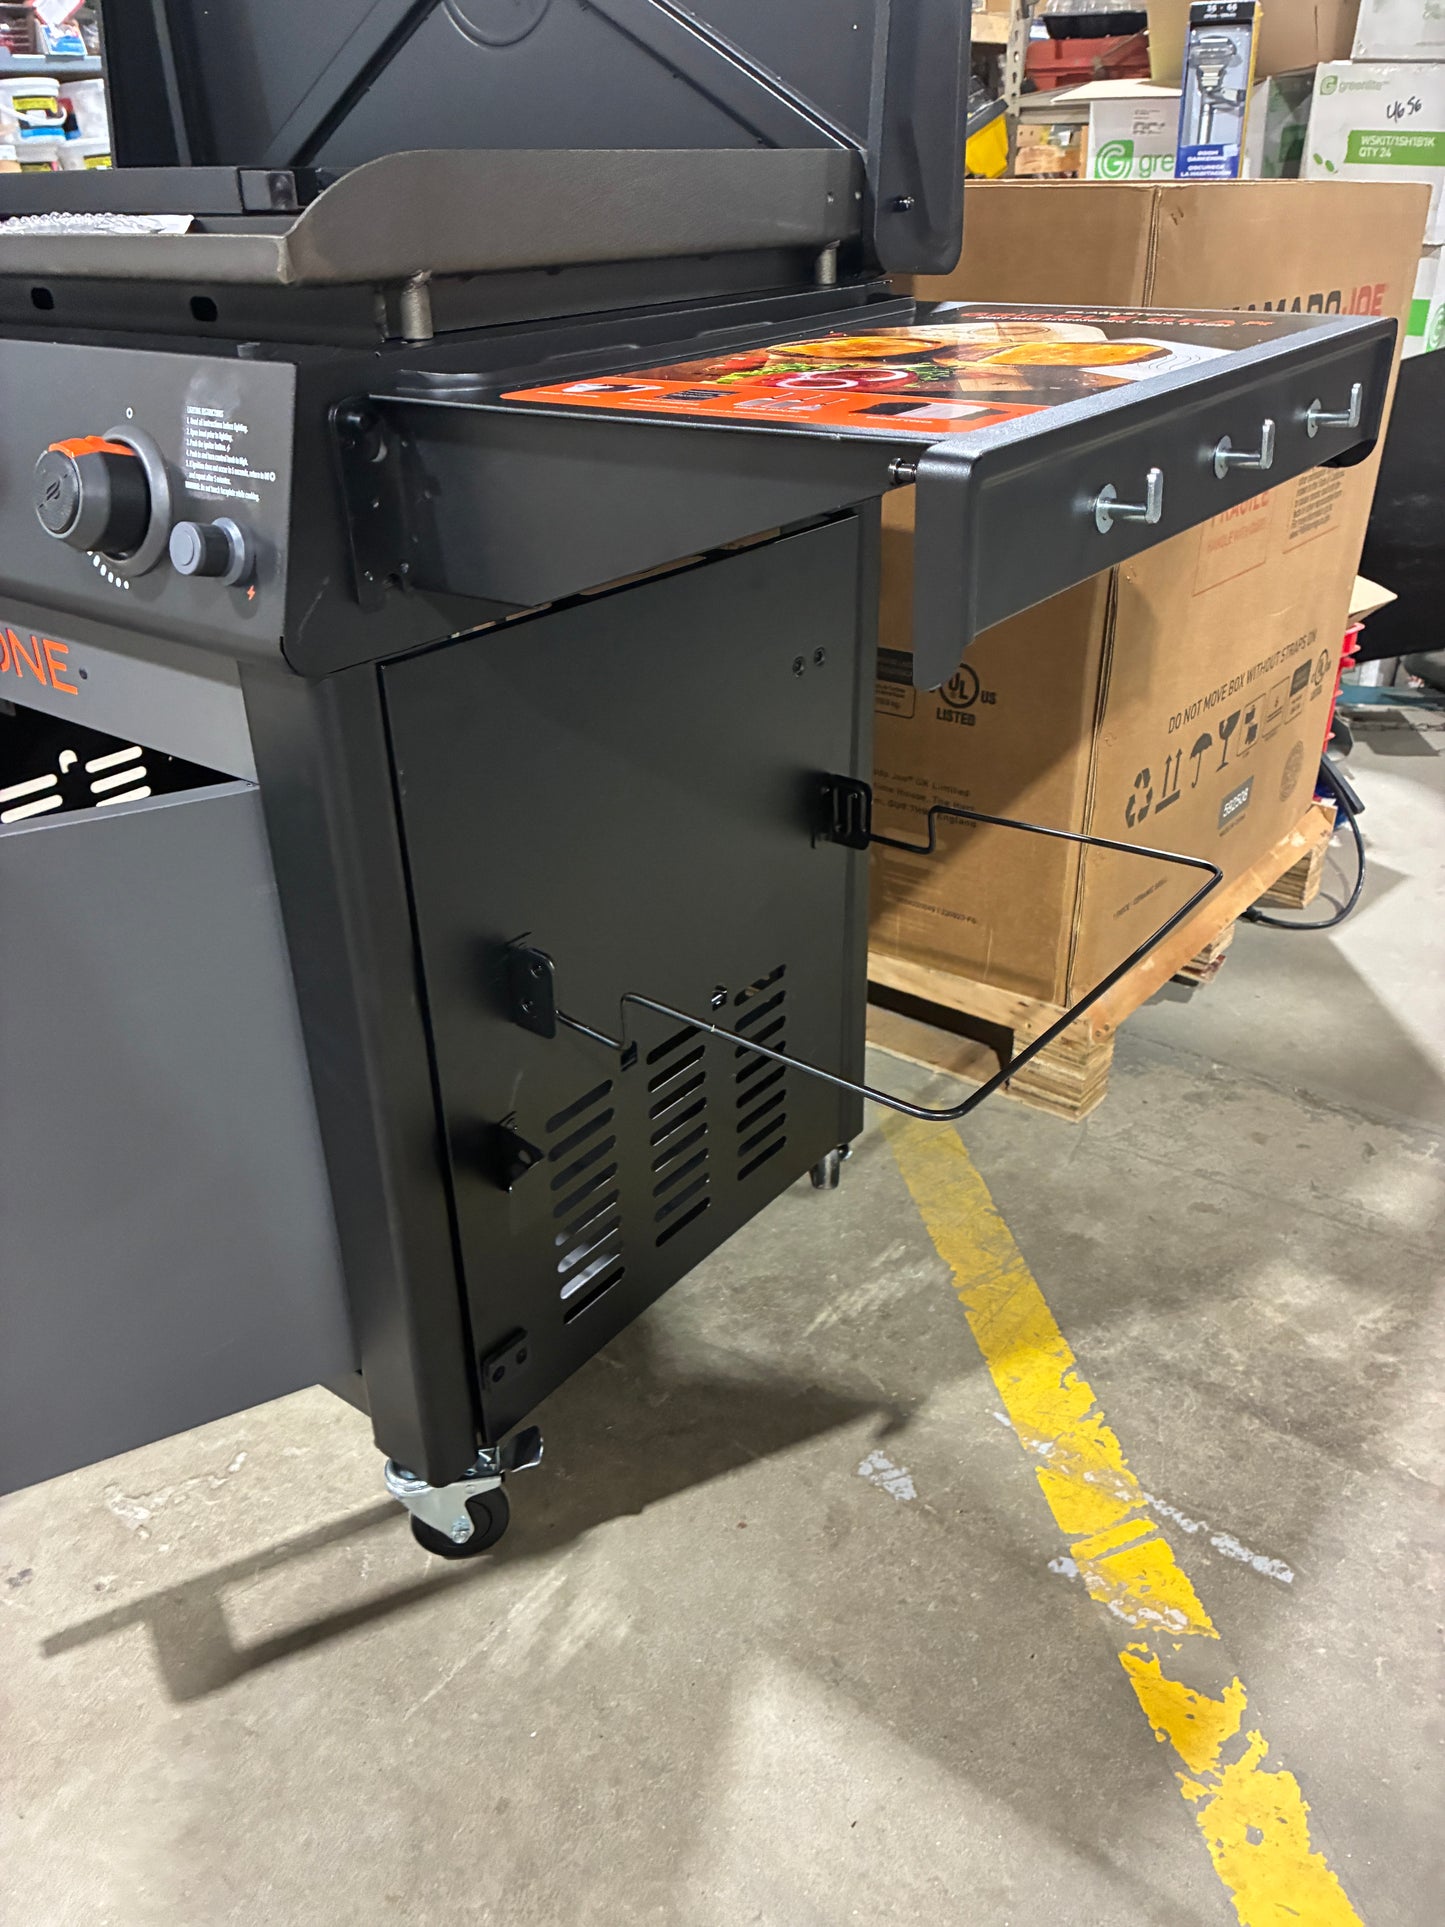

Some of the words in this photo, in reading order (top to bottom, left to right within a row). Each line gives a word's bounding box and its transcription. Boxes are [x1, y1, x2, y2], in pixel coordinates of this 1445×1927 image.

[1359, 147, 1379, 158] QTY
[1139, 153, 1174, 178] gre
[1168, 713, 1183, 734] DO
[1183, 699, 1204, 724] NOT
[1203, 684, 1228, 713] MOVE
[1228, 673, 1245, 696] BOX
[1246, 653, 1281, 684] WITHOUT
[1281, 634, 1307, 663] STRAPS
[980, 690, 997, 705] US
[936, 707, 977, 727] LISTED
